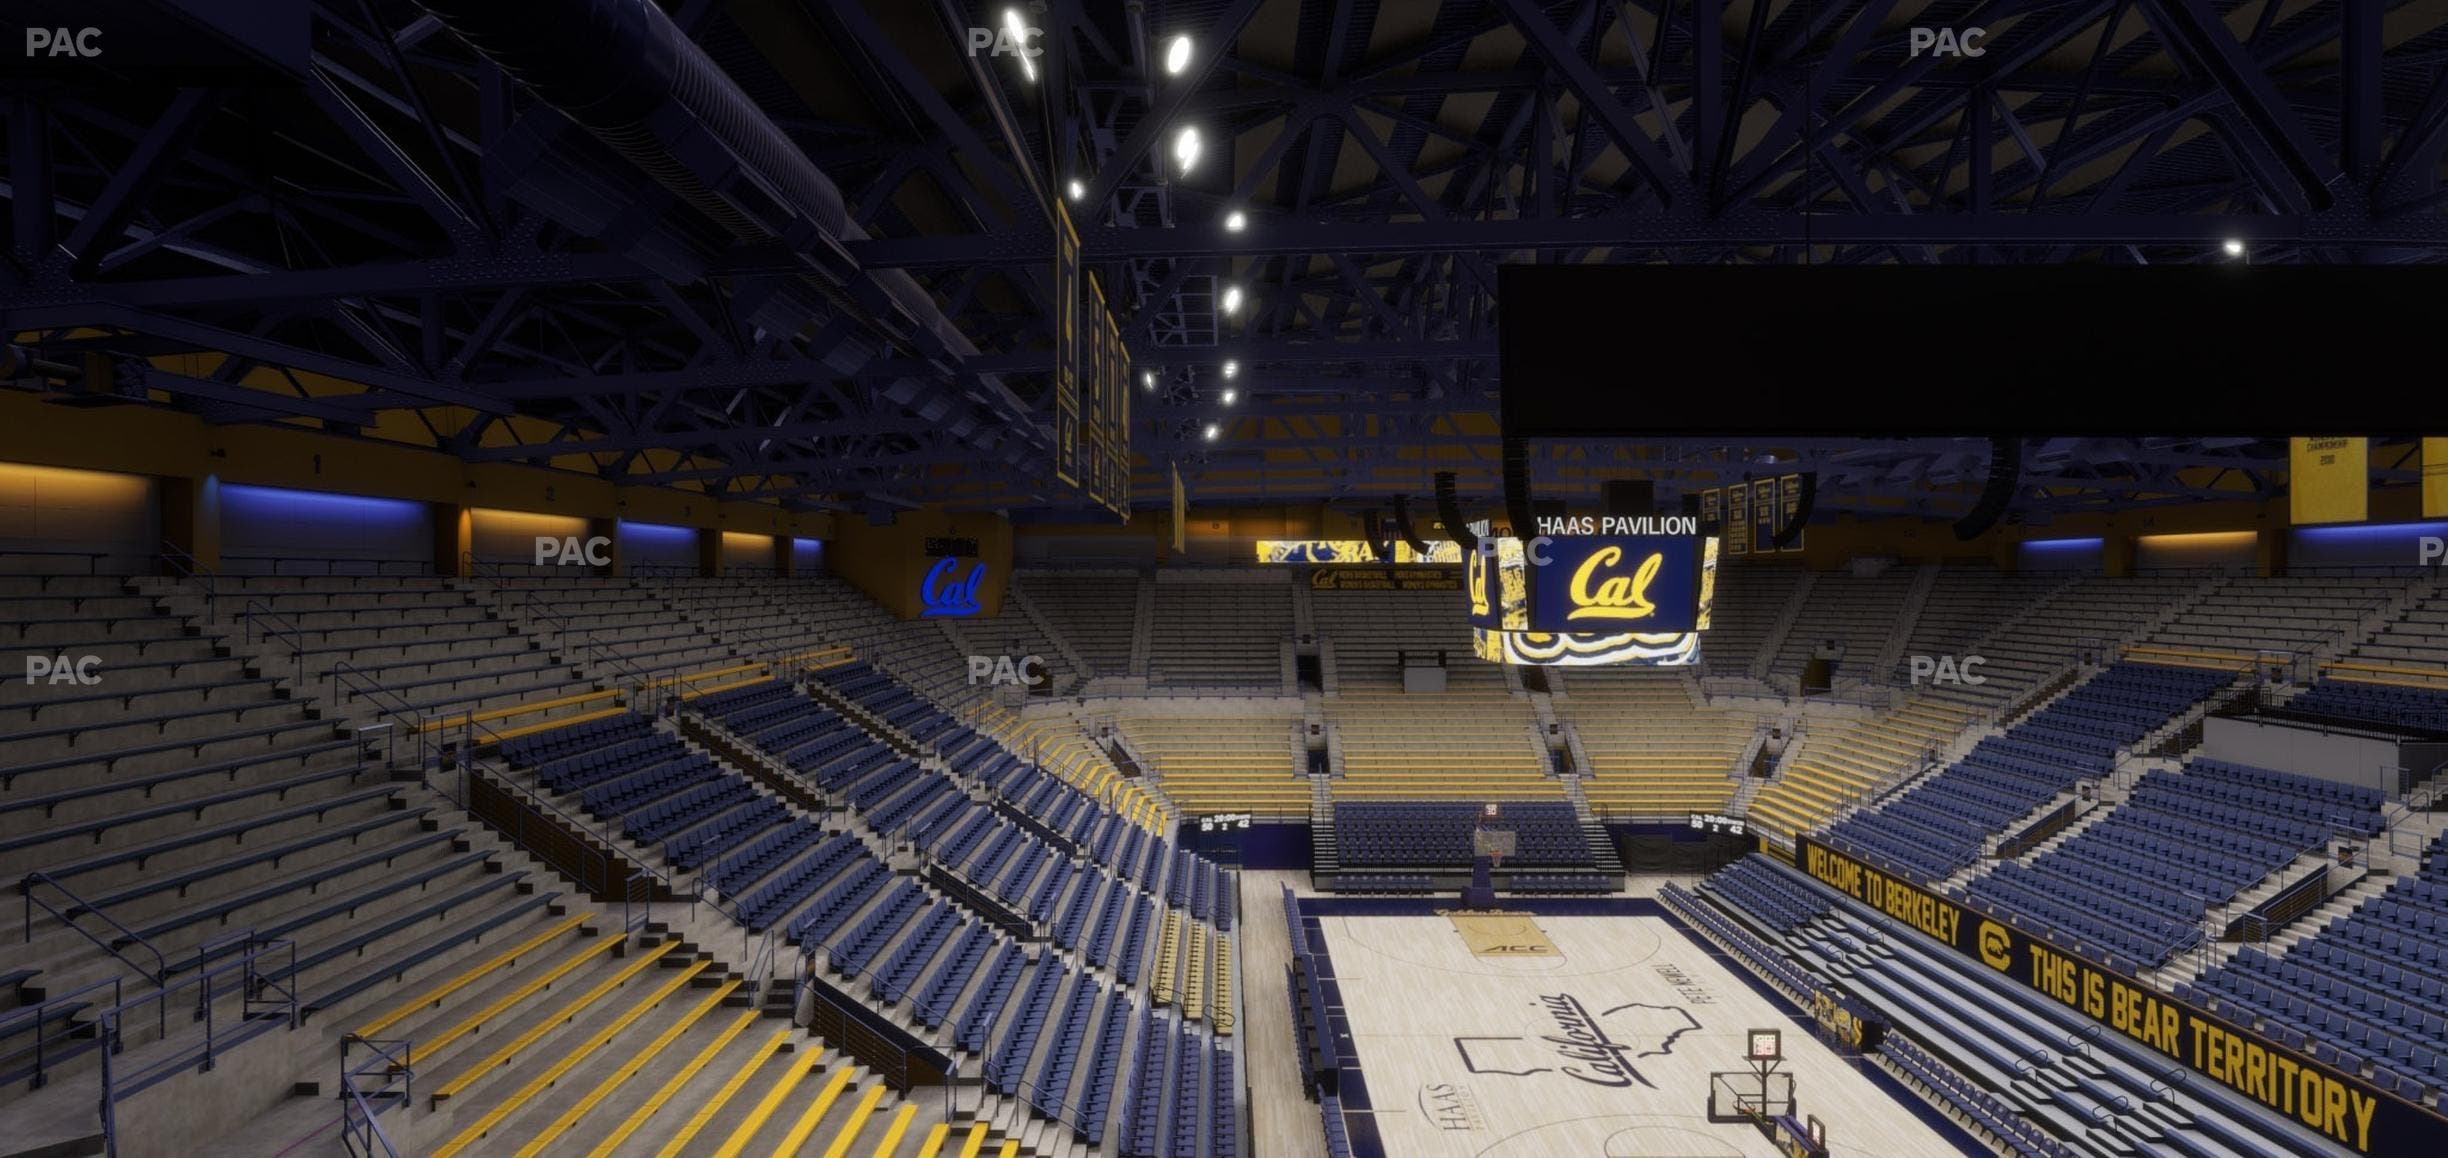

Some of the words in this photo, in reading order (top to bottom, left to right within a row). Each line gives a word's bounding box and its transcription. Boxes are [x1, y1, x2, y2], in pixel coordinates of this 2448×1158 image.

[1537, 516, 1594, 535] HAAS
[1603, 516, 1696, 535] PAVILION
[919, 555, 987, 617] Cal
[1567, 546, 1664, 620] Cal
[1729, 825, 1744, 835] 42
[1807, 844, 1861, 898] WELCOME
[1865, 870, 1882, 907] TO
[1886, 879, 1959, 945] BERKELEY
[1529, 993, 1659, 1090] California
[2030, 944, 2076, 1005] THIS
[2083, 969, 2104, 1018] IS
[2112, 982, 2179, 1057] BEAR
[2190, 1017, 2376, 1151] TERRITORY
[1426, 1083, 1471, 1131] HAAS
